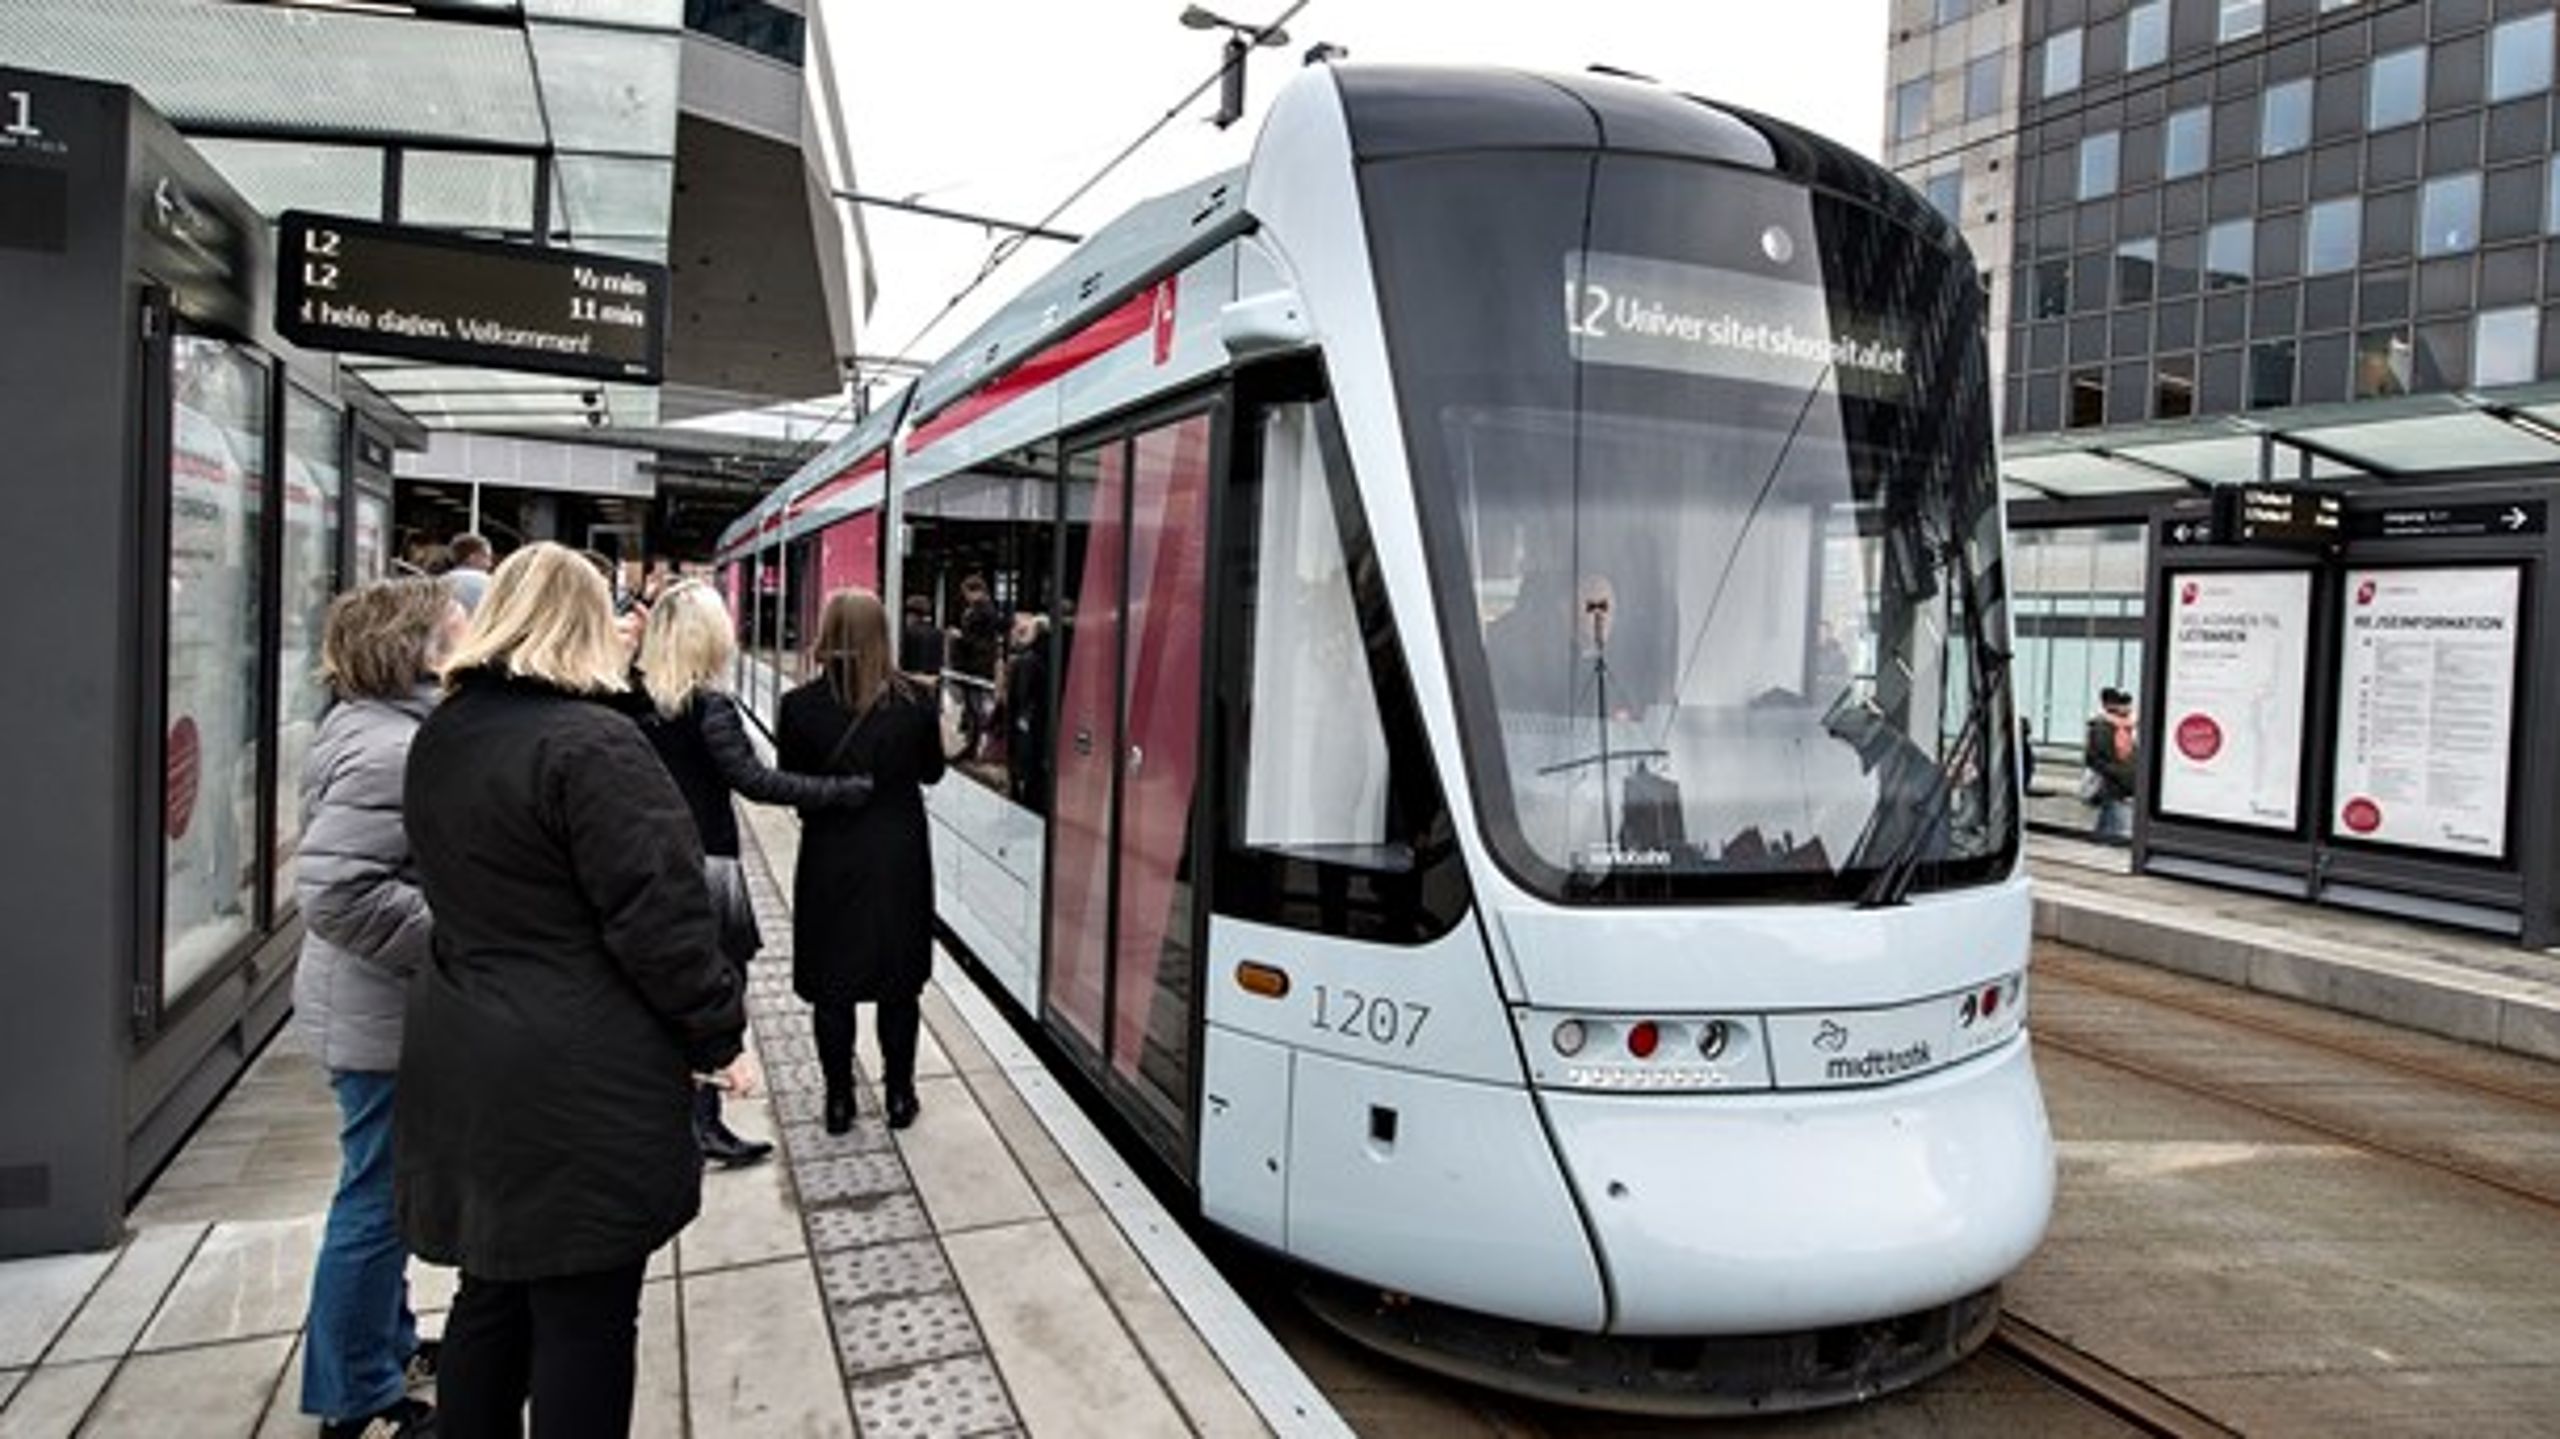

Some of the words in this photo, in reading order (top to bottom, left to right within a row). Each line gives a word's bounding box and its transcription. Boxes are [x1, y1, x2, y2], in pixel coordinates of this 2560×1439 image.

[5, 91, 42, 136] 1
[304, 229, 341, 257] L2
[602, 272, 647, 295] min
[304, 263, 339, 290] L2
[570, 297, 597, 320] 11
[600, 302, 645, 328] min
[320, 300, 370, 329] hele
[1565, 280, 1610, 337] L2
[1615, 295, 1906, 374] Universitetshospitalet
[1310, 985, 1432, 1047] 1207
